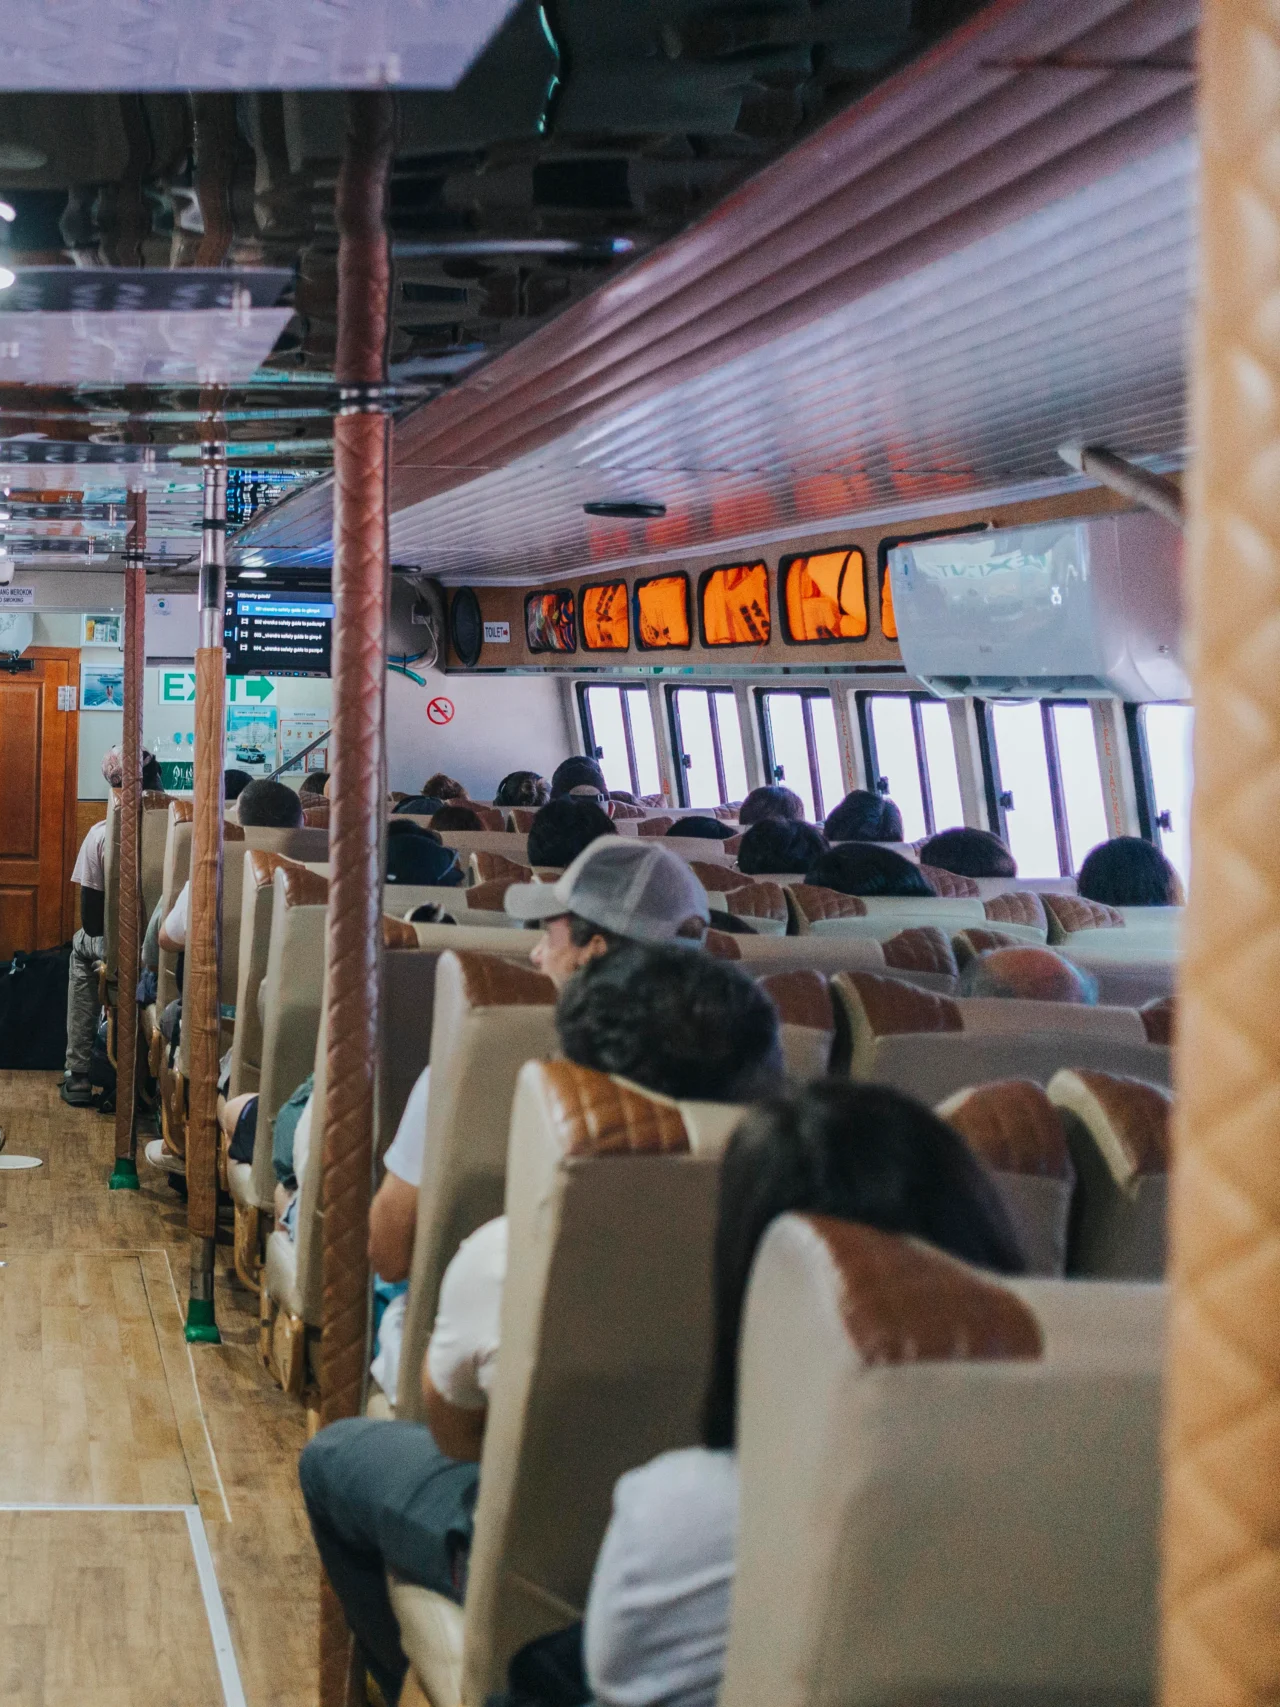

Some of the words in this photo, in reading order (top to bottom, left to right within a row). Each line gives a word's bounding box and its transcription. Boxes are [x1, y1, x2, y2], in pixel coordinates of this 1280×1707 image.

[10, 588, 32, 596] MEROKOK
[485, 626, 503, 638] TOILET
[164, 673, 244, 702] ET
[845, 740, 854, 793] JACKE
